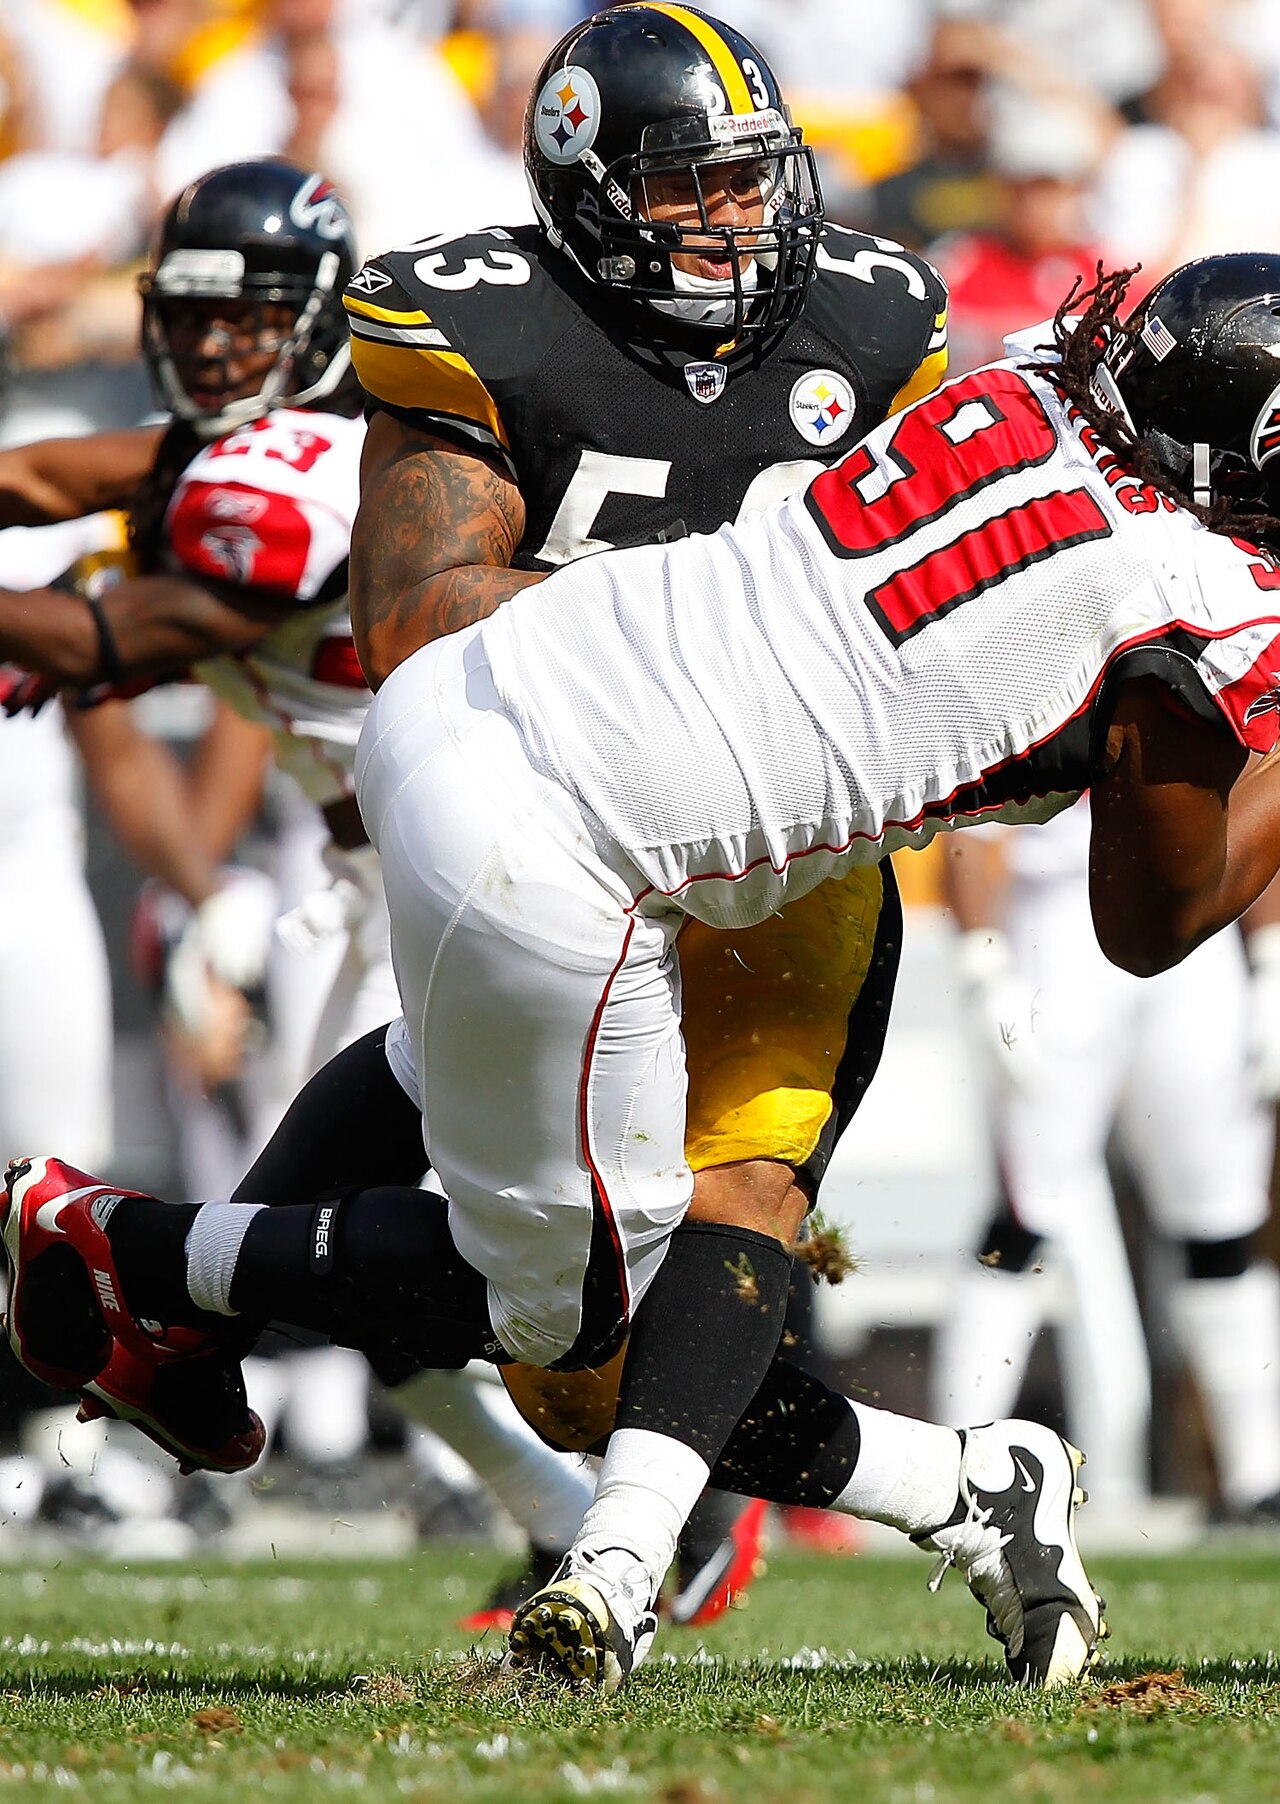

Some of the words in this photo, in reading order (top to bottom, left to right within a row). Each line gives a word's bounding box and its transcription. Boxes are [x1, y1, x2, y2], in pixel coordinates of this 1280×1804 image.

[795, 400, 820, 412] Steelers
[803, 368, 1114, 651] 91
[93, 1267, 121, 1314] NIKE
